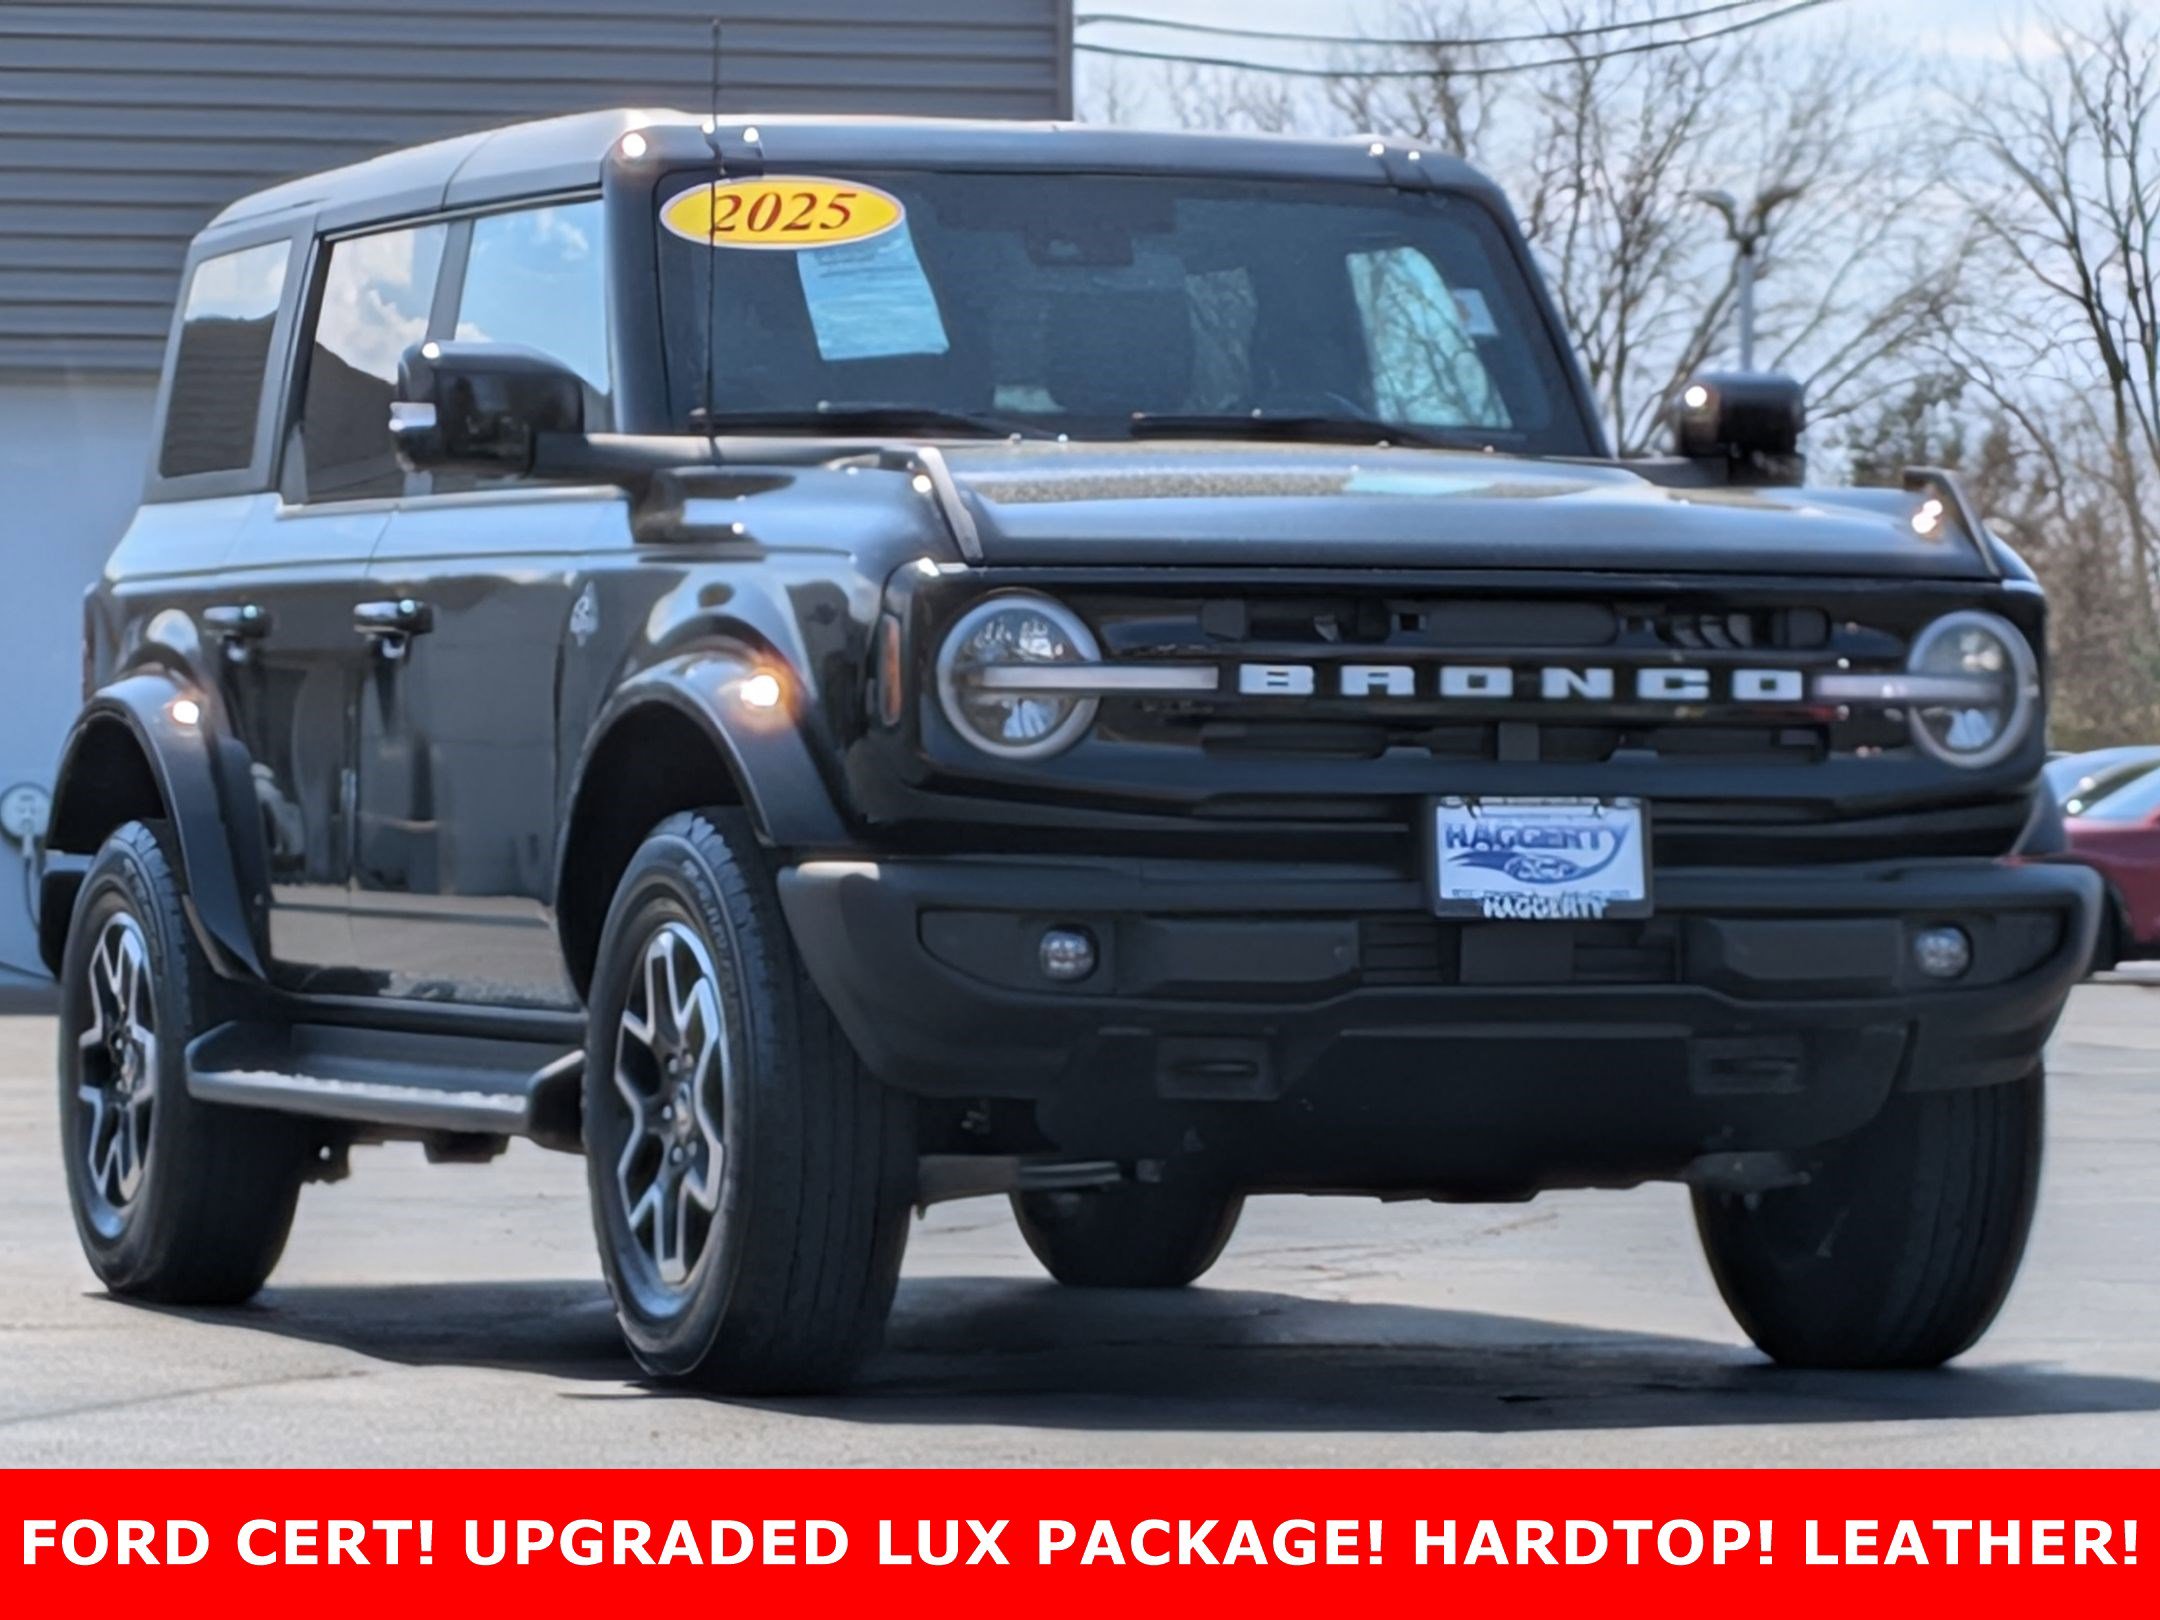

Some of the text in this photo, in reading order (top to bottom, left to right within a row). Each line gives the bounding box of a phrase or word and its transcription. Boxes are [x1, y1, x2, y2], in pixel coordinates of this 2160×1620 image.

[711, 191, 857, 232] 2025
[1239, 663, 1803, 700] BRONCO
[1445, 821, 1632, 851] HAGGERTY
